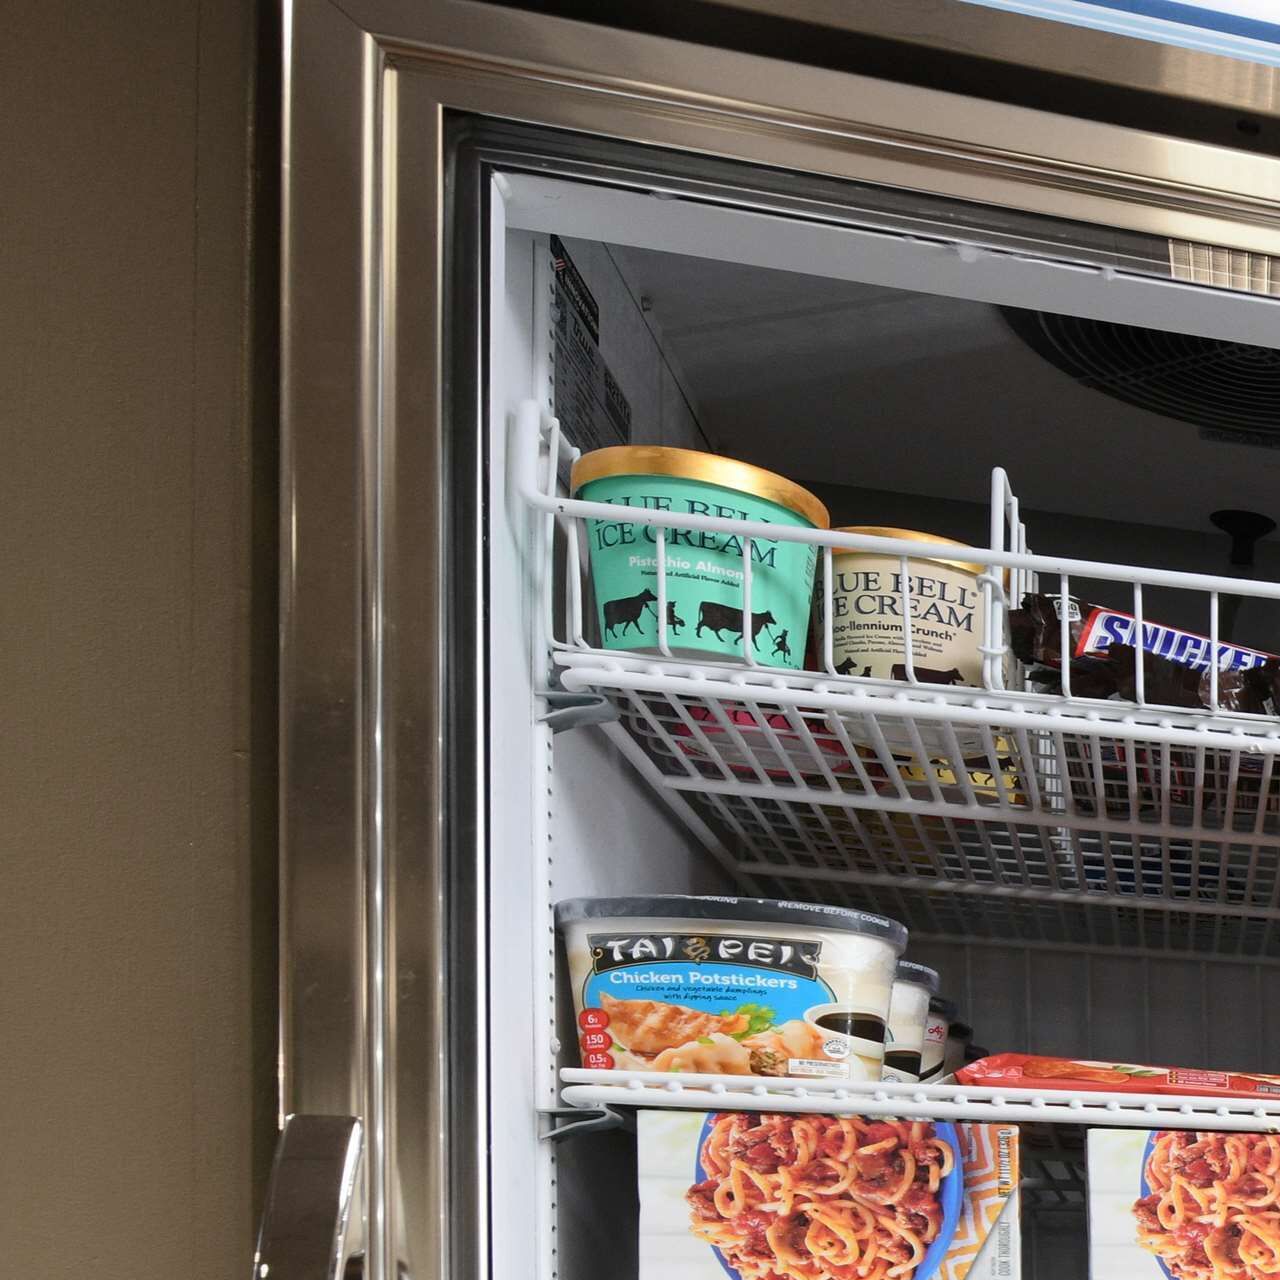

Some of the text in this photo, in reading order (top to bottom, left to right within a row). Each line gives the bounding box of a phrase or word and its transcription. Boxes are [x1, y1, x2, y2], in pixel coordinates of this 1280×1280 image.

[595, 520, 777, 569] ICE CREAM
[890, 572, 975, 610] BELL
[855, 594, 974, 632] CREAM
[908, 624, 953, 642] Crunch
[1096, 613, 1268, 673] SNICKE
[778, 900, 858, 919] REMOVE BEFORE
[605, 938, 795, 965] TAI PEI
[609, 971, 798, 990] Chicken Potstickers
[585, 1034, 604, 1045] 150
